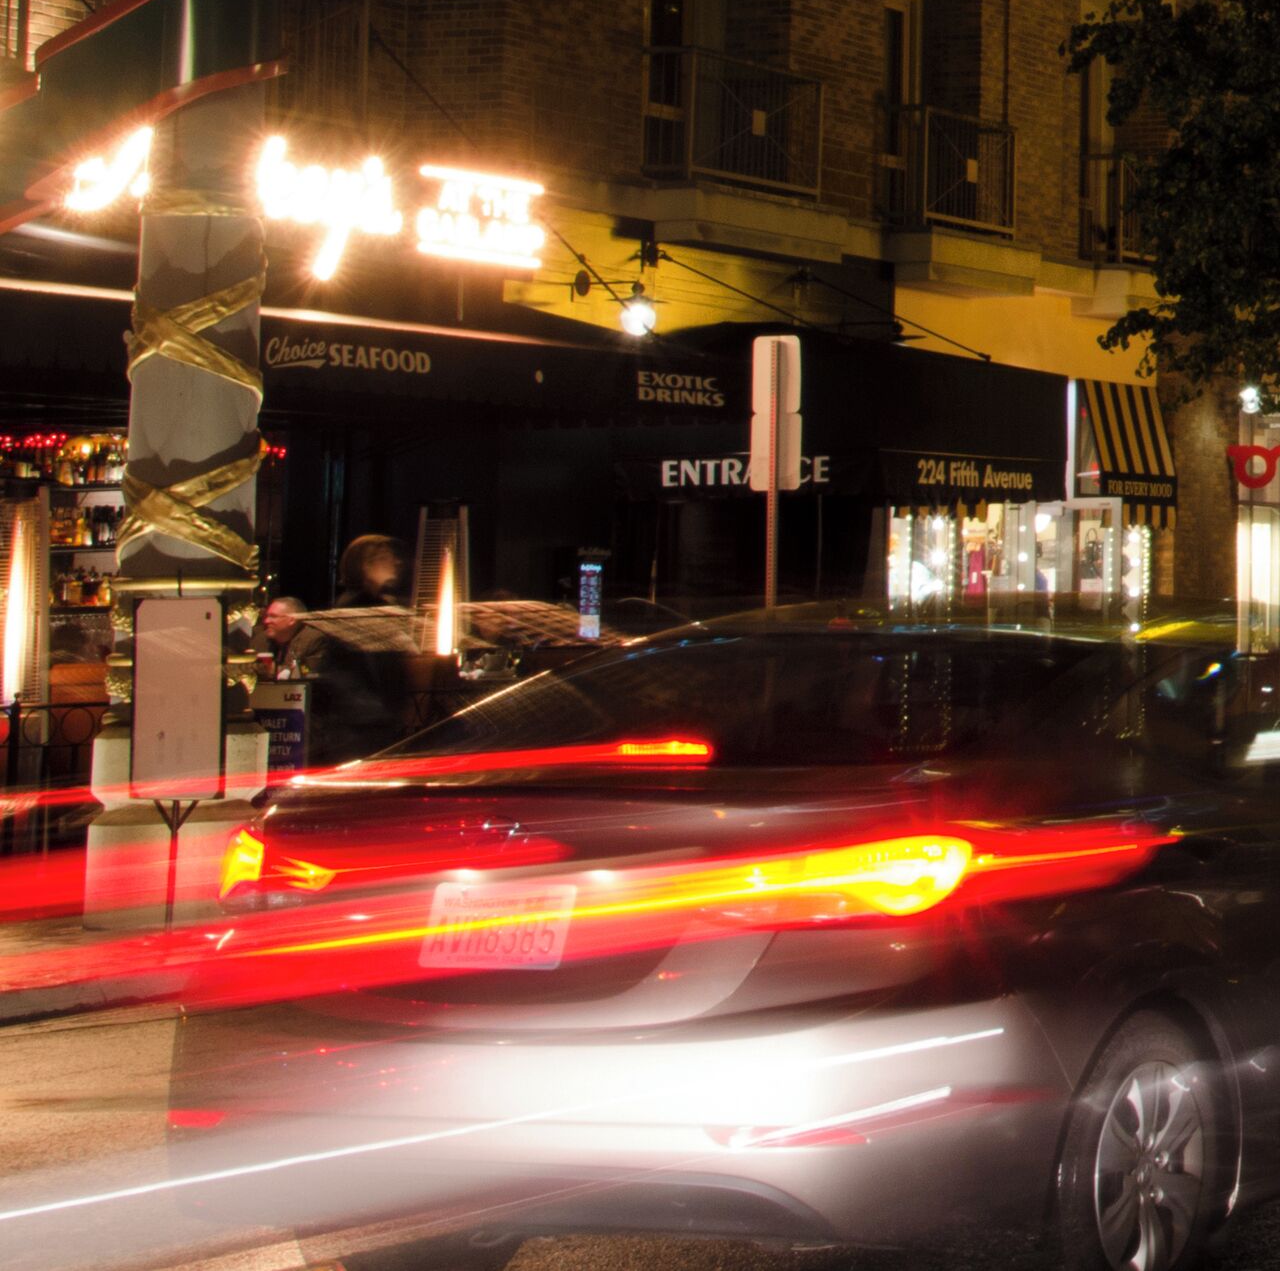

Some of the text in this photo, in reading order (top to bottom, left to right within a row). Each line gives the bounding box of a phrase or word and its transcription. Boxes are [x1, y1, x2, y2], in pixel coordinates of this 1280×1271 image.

[265, 335, 432, 374] Choice SEAFOOD
[637, 370, 719, 393] EXOTIC
[637, 386, 726, 408] DRINKS
[661, 455, 831, 488] ENTRCE
[917, 459, 1033, 490] 224 Fifth Avenue
[1107, 479, 1173, 498] FOR EVERY MOOD
[284, 693, 302, 702] LAZ
[261, 718, 287, 729] VALET
[271, 731, 301, 743] ETURN
